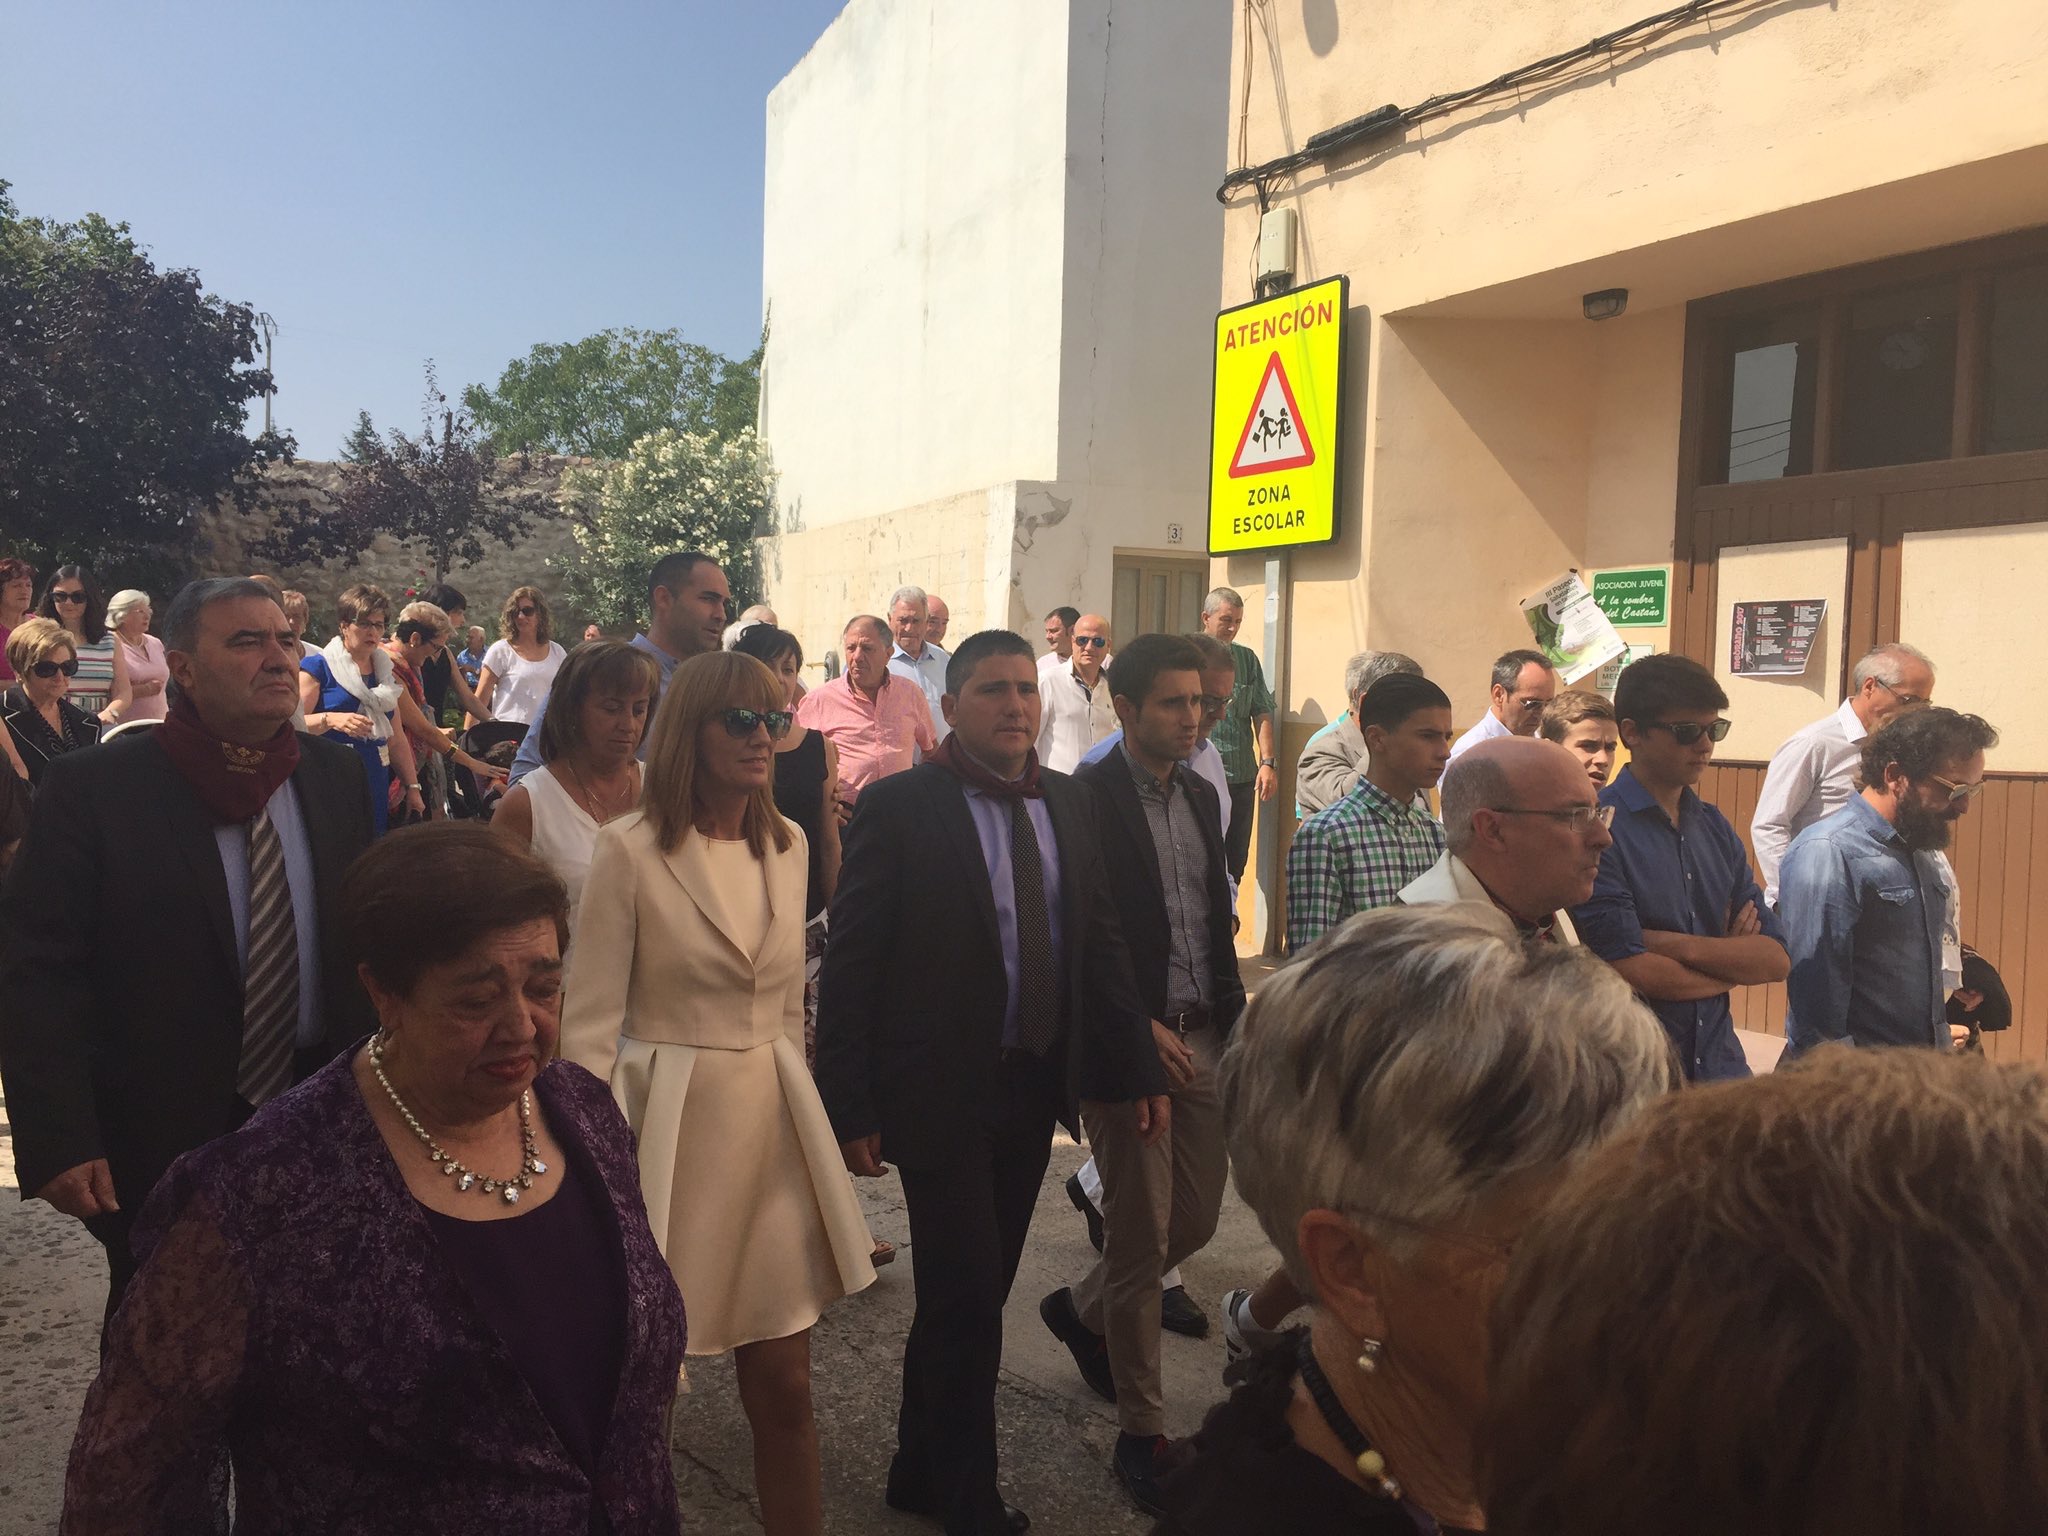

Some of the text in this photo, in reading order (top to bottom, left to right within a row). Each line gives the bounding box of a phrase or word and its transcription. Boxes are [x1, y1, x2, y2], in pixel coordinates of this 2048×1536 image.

[1224, 300, 1333, 352] ATENCIÓN
[1247, 484, 1291, 506] ZONA
[1233, 509, 1305, 534] ESCOLAR
[1171, 527, 1178, 539] 3
[1595, 579, 1664, 590] ASOCIACION JUVENIL
[1597, 594, 1607, 606] A
[1609, 595, 1620, 605] la
[1622, 593, 1655, 605] sombra
[1605, 606, 1660, 620] del Castaño
